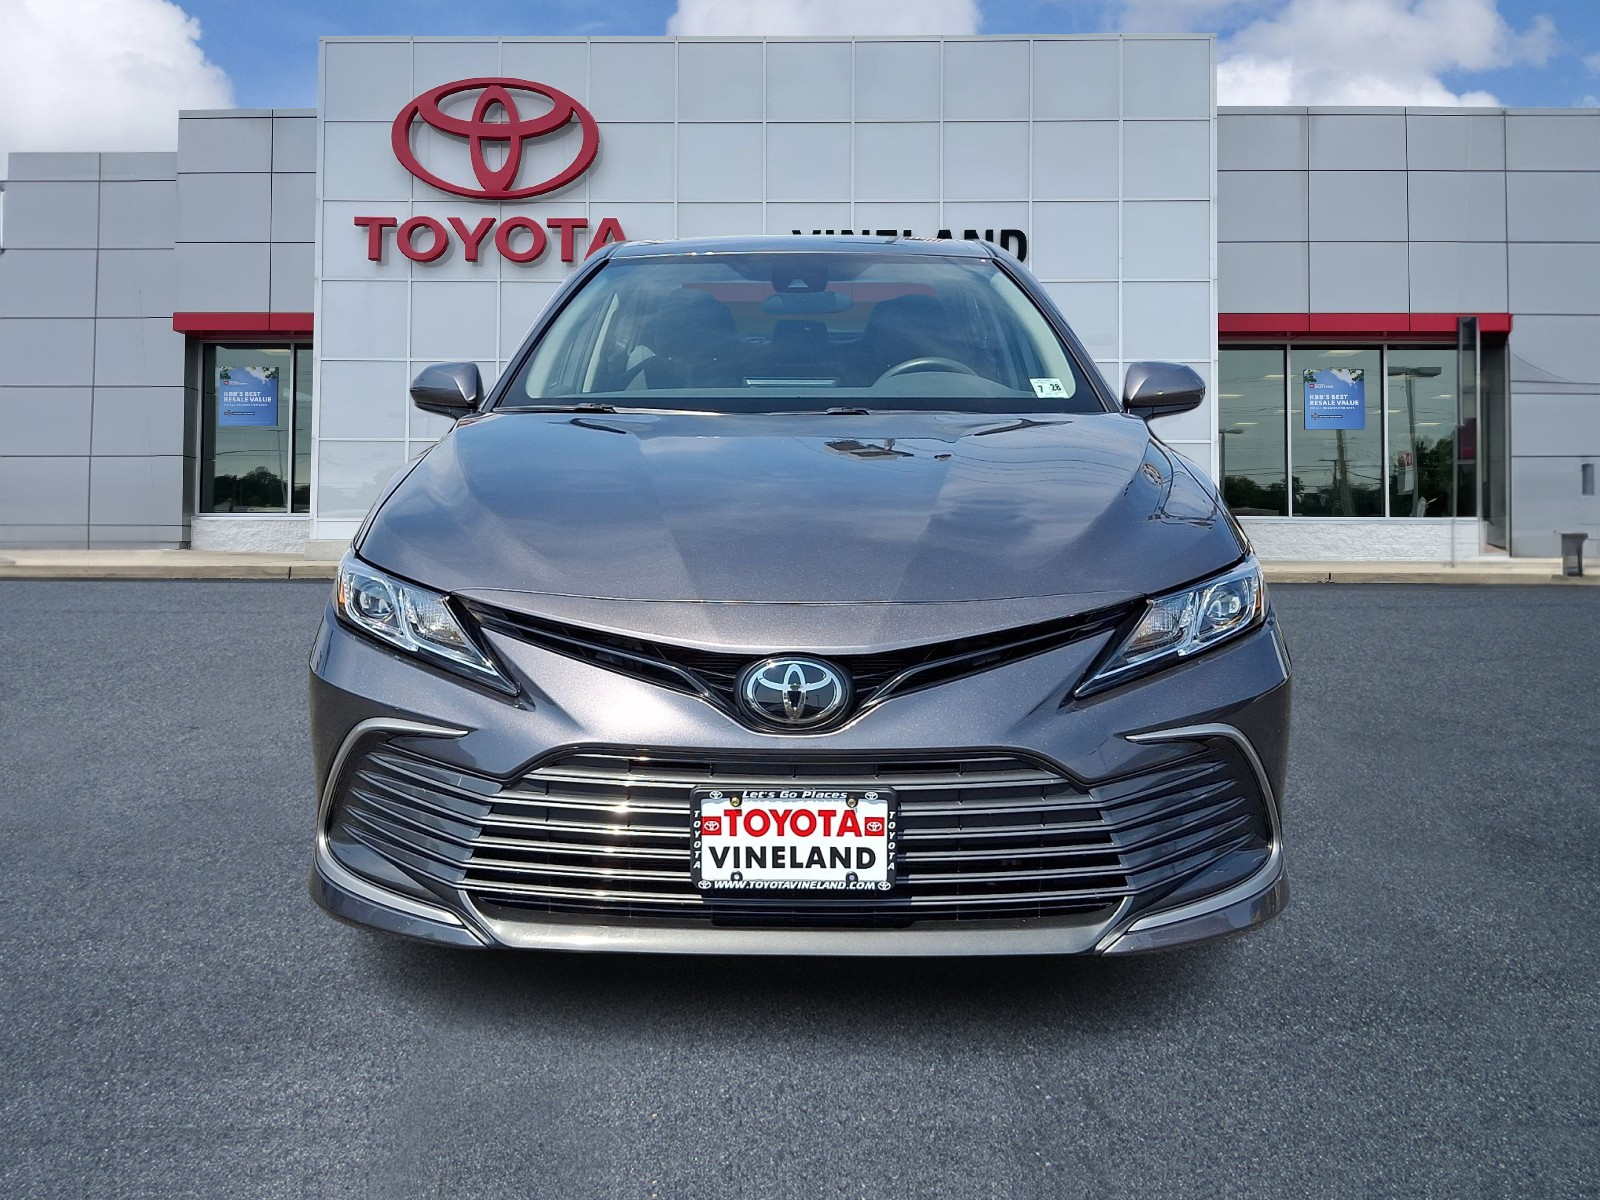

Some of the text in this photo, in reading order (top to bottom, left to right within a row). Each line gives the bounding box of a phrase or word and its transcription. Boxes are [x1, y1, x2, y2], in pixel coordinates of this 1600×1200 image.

[354, 216, 627, 263] TOYOTA
[1037, 383, 1062, 393] 7 28
[742, 790, 848, 799] Let's Go Places
[723, 808, 863, 838] TOYOTA
[693, 810, 702, 869] TOYOTA
[887, 811, 896, 871] TOYOTA
[708, 846, 877, 870] VINELAND
[714, 880, 876, 890] WWW.TOYOTAVINELAND.COM
